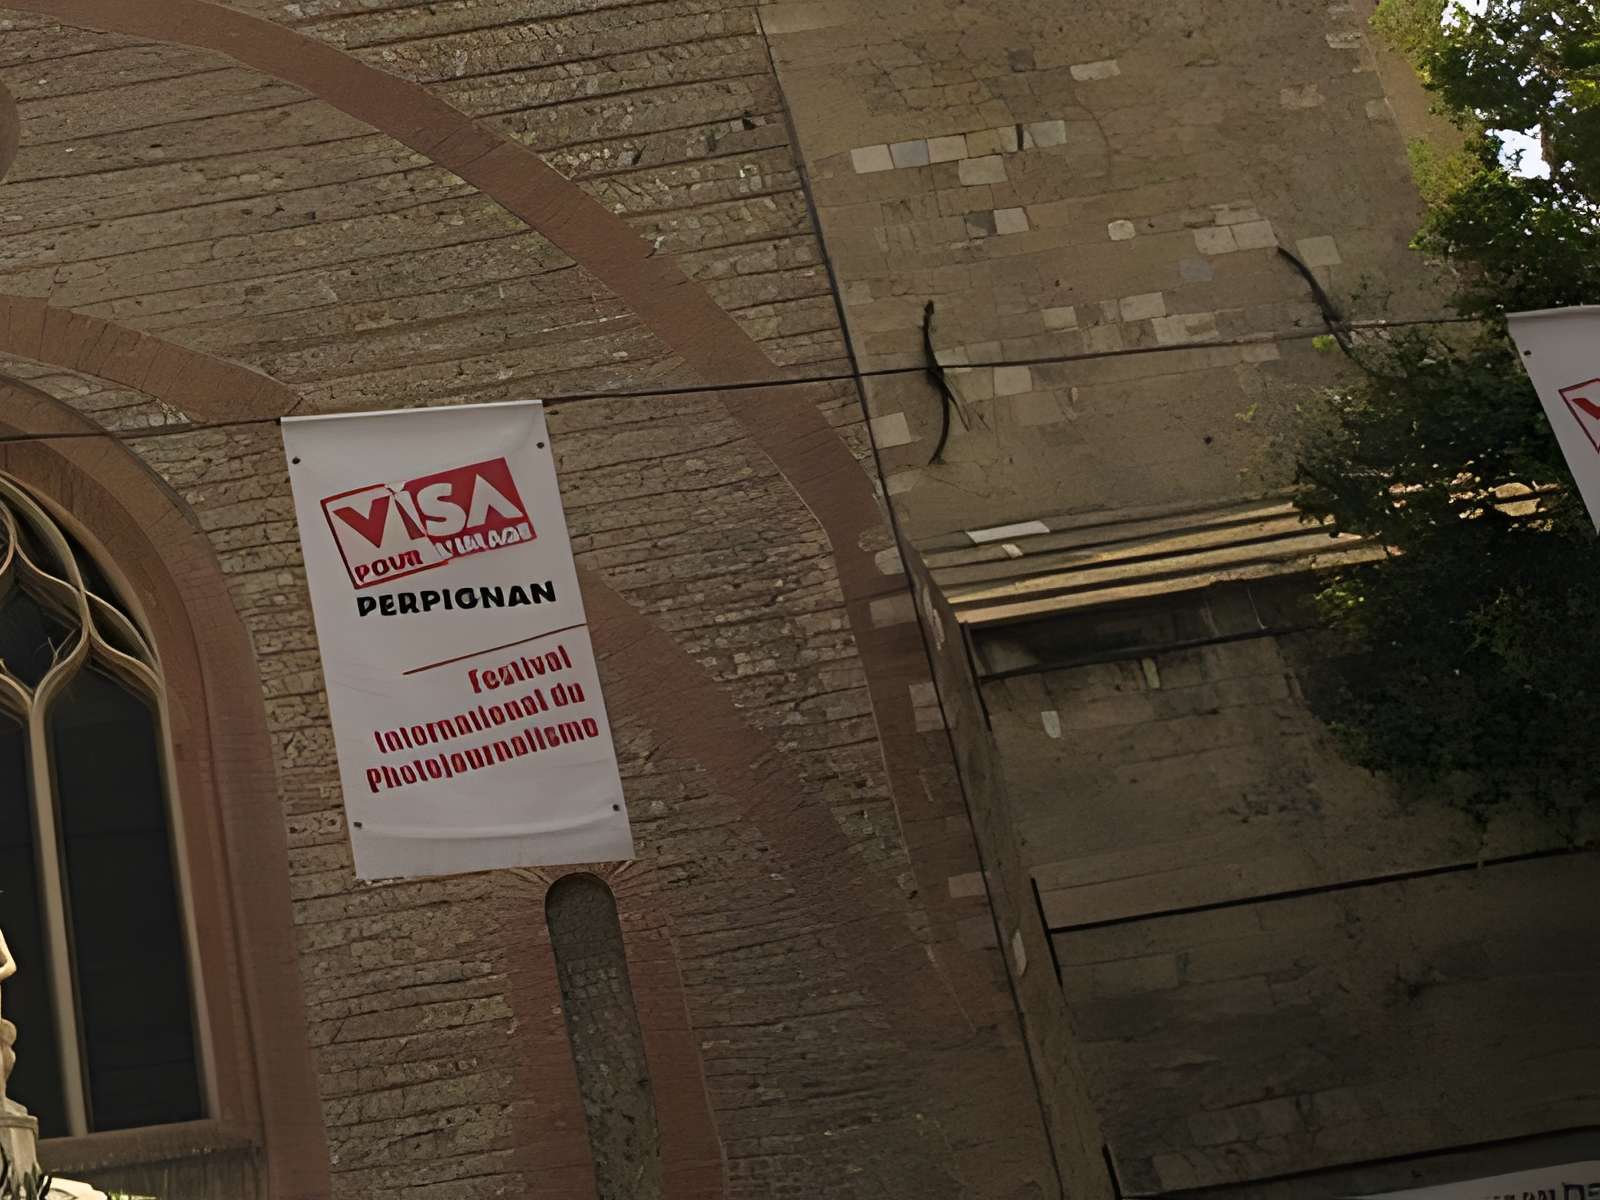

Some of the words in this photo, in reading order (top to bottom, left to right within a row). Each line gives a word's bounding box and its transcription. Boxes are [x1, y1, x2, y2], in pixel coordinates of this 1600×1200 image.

[353, 549, 424, 583] POUR
[356, 580, 557, 618] PERPIGNAN
[550, 681, 586, 707] du
